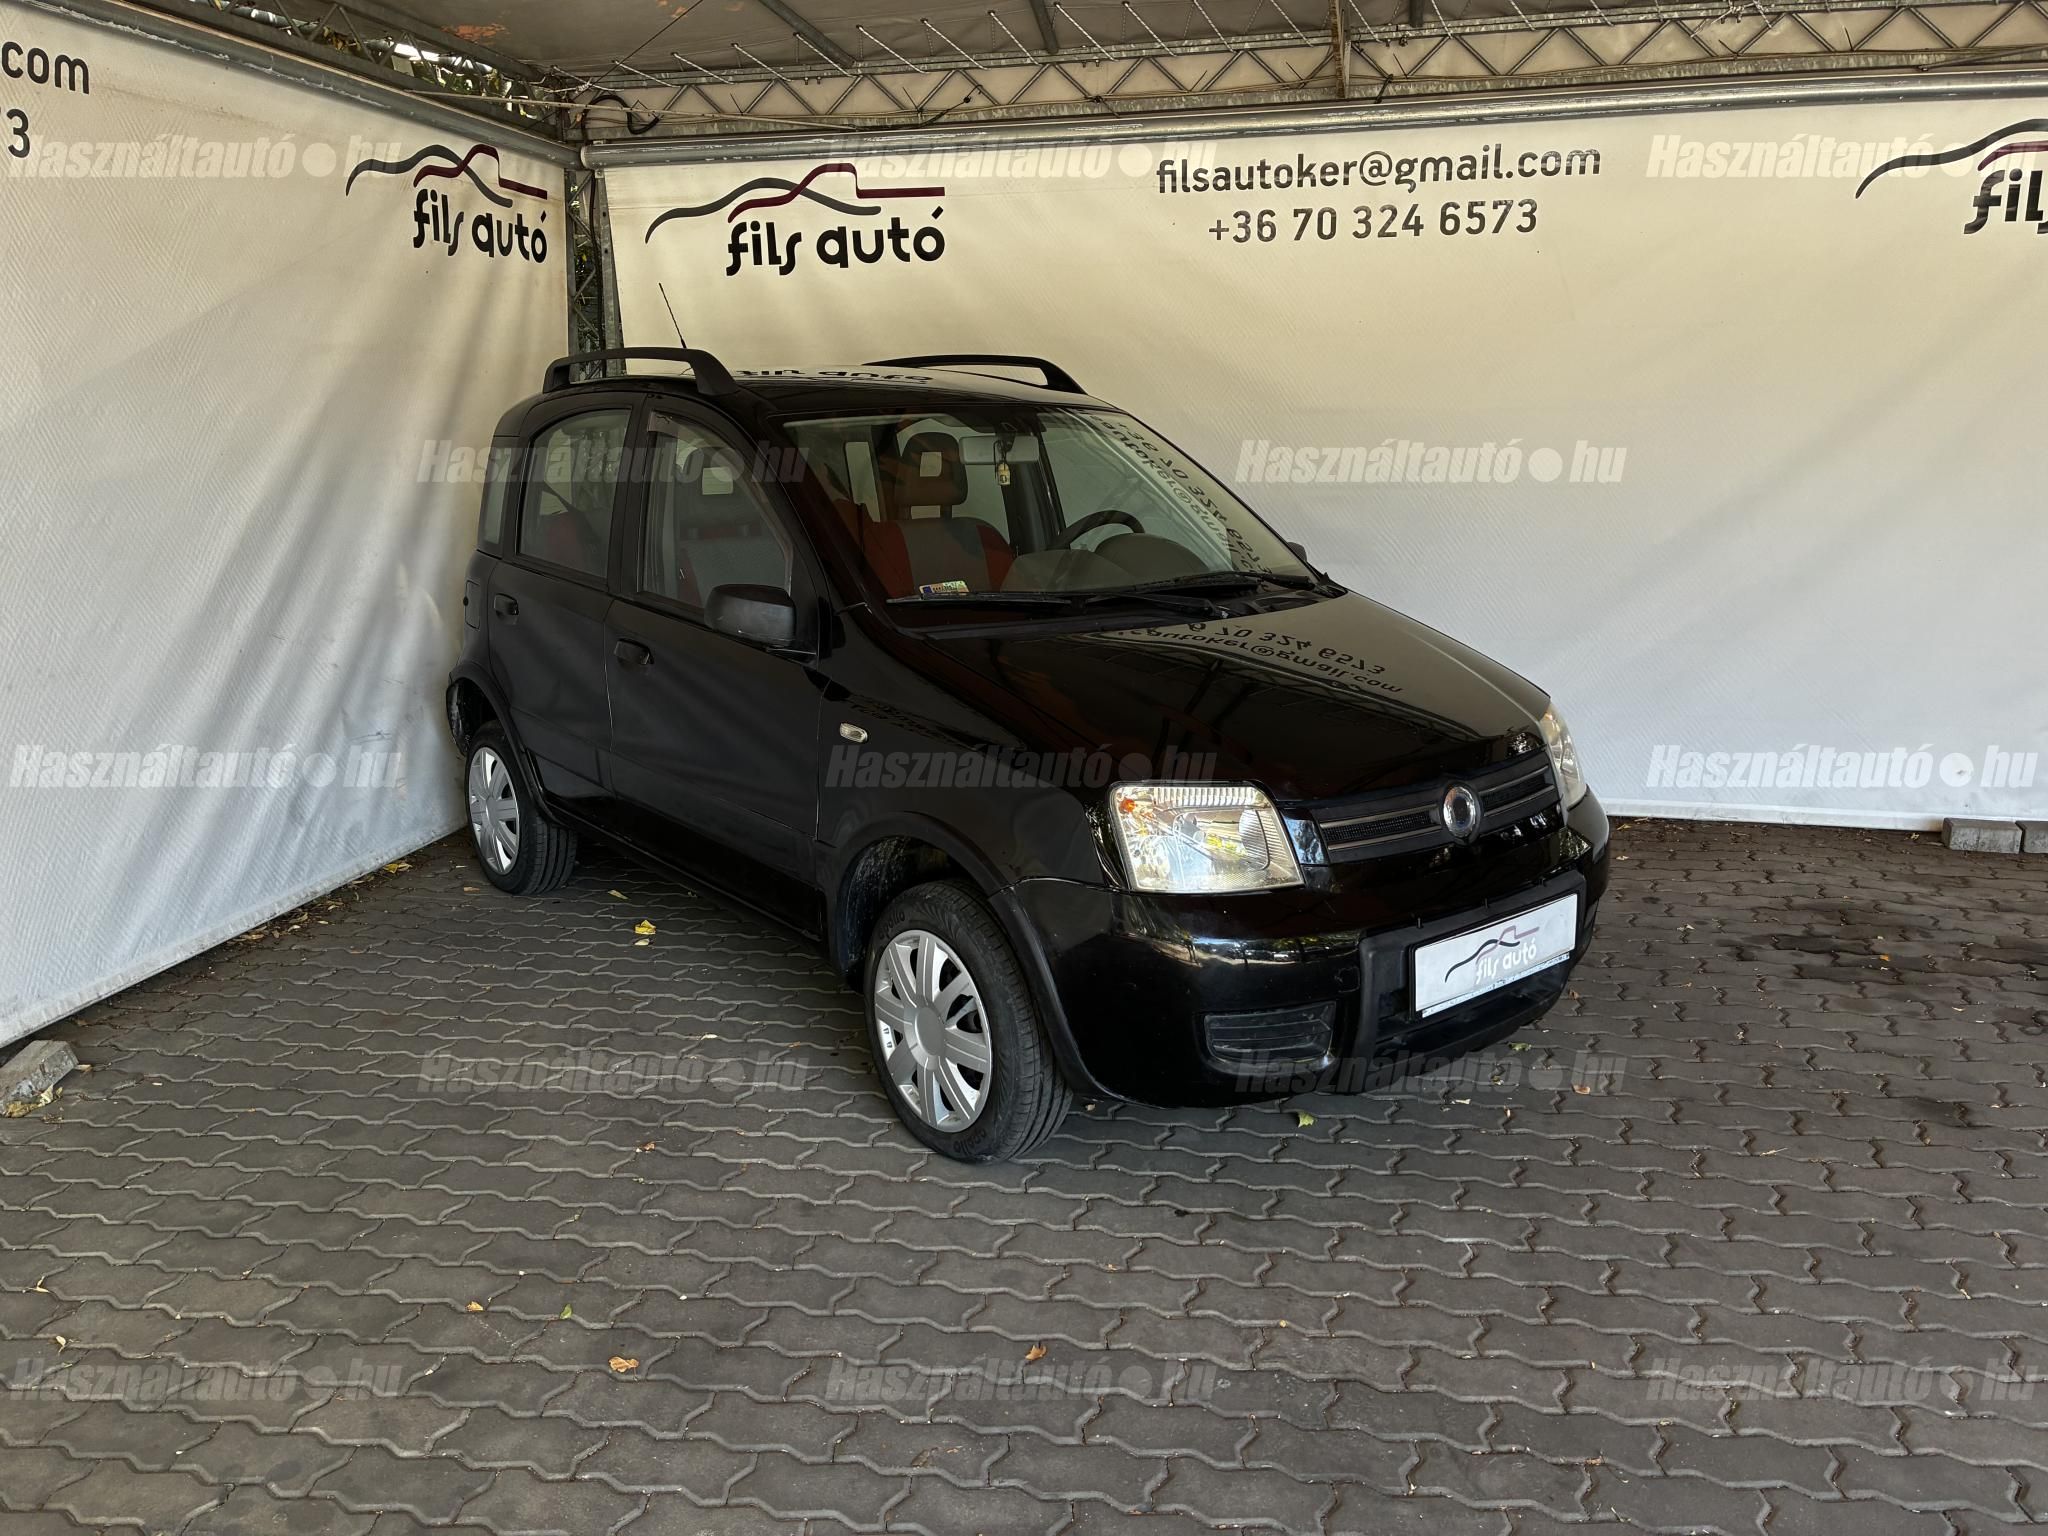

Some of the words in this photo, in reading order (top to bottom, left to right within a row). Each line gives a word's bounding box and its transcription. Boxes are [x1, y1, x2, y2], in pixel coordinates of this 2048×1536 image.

[1156, 144, 1601, 194] filsautoker@gmail.com
[413, 189, 464, 256] fils
[472, 211, 548, 263] autó
[1208, 210, 1277, 243] +36
[1293, 207, 1338, 241] 70
[1352, 203, 1425, 239] 324
[1439, 198, 1538, 236] 6573
[1963, 168, 2048, 235] fil
[726, 220, 802, 276] fils
[816, 206, 945, 268] autó
[1476, 957, 1499, 985] fils
[1503, 937, 1537, 970] autó
